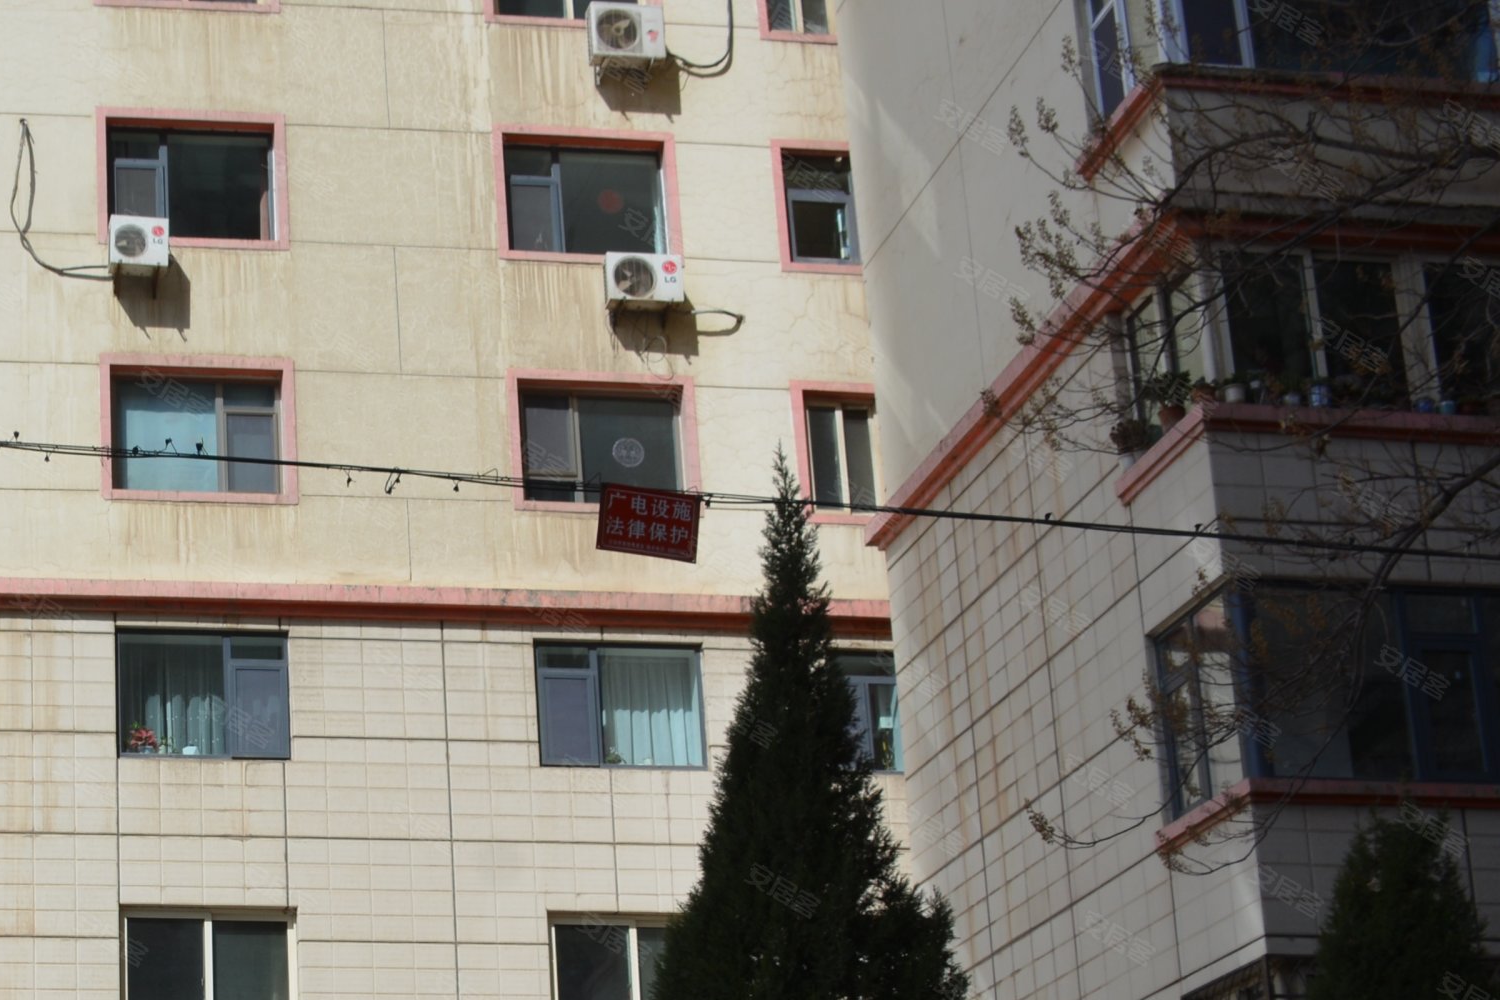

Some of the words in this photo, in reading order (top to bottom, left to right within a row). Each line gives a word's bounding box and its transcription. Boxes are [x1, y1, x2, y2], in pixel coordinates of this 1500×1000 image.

[607, 493, 692, 521] 广电设施
[606, 516, 689, 545] 法律保护
